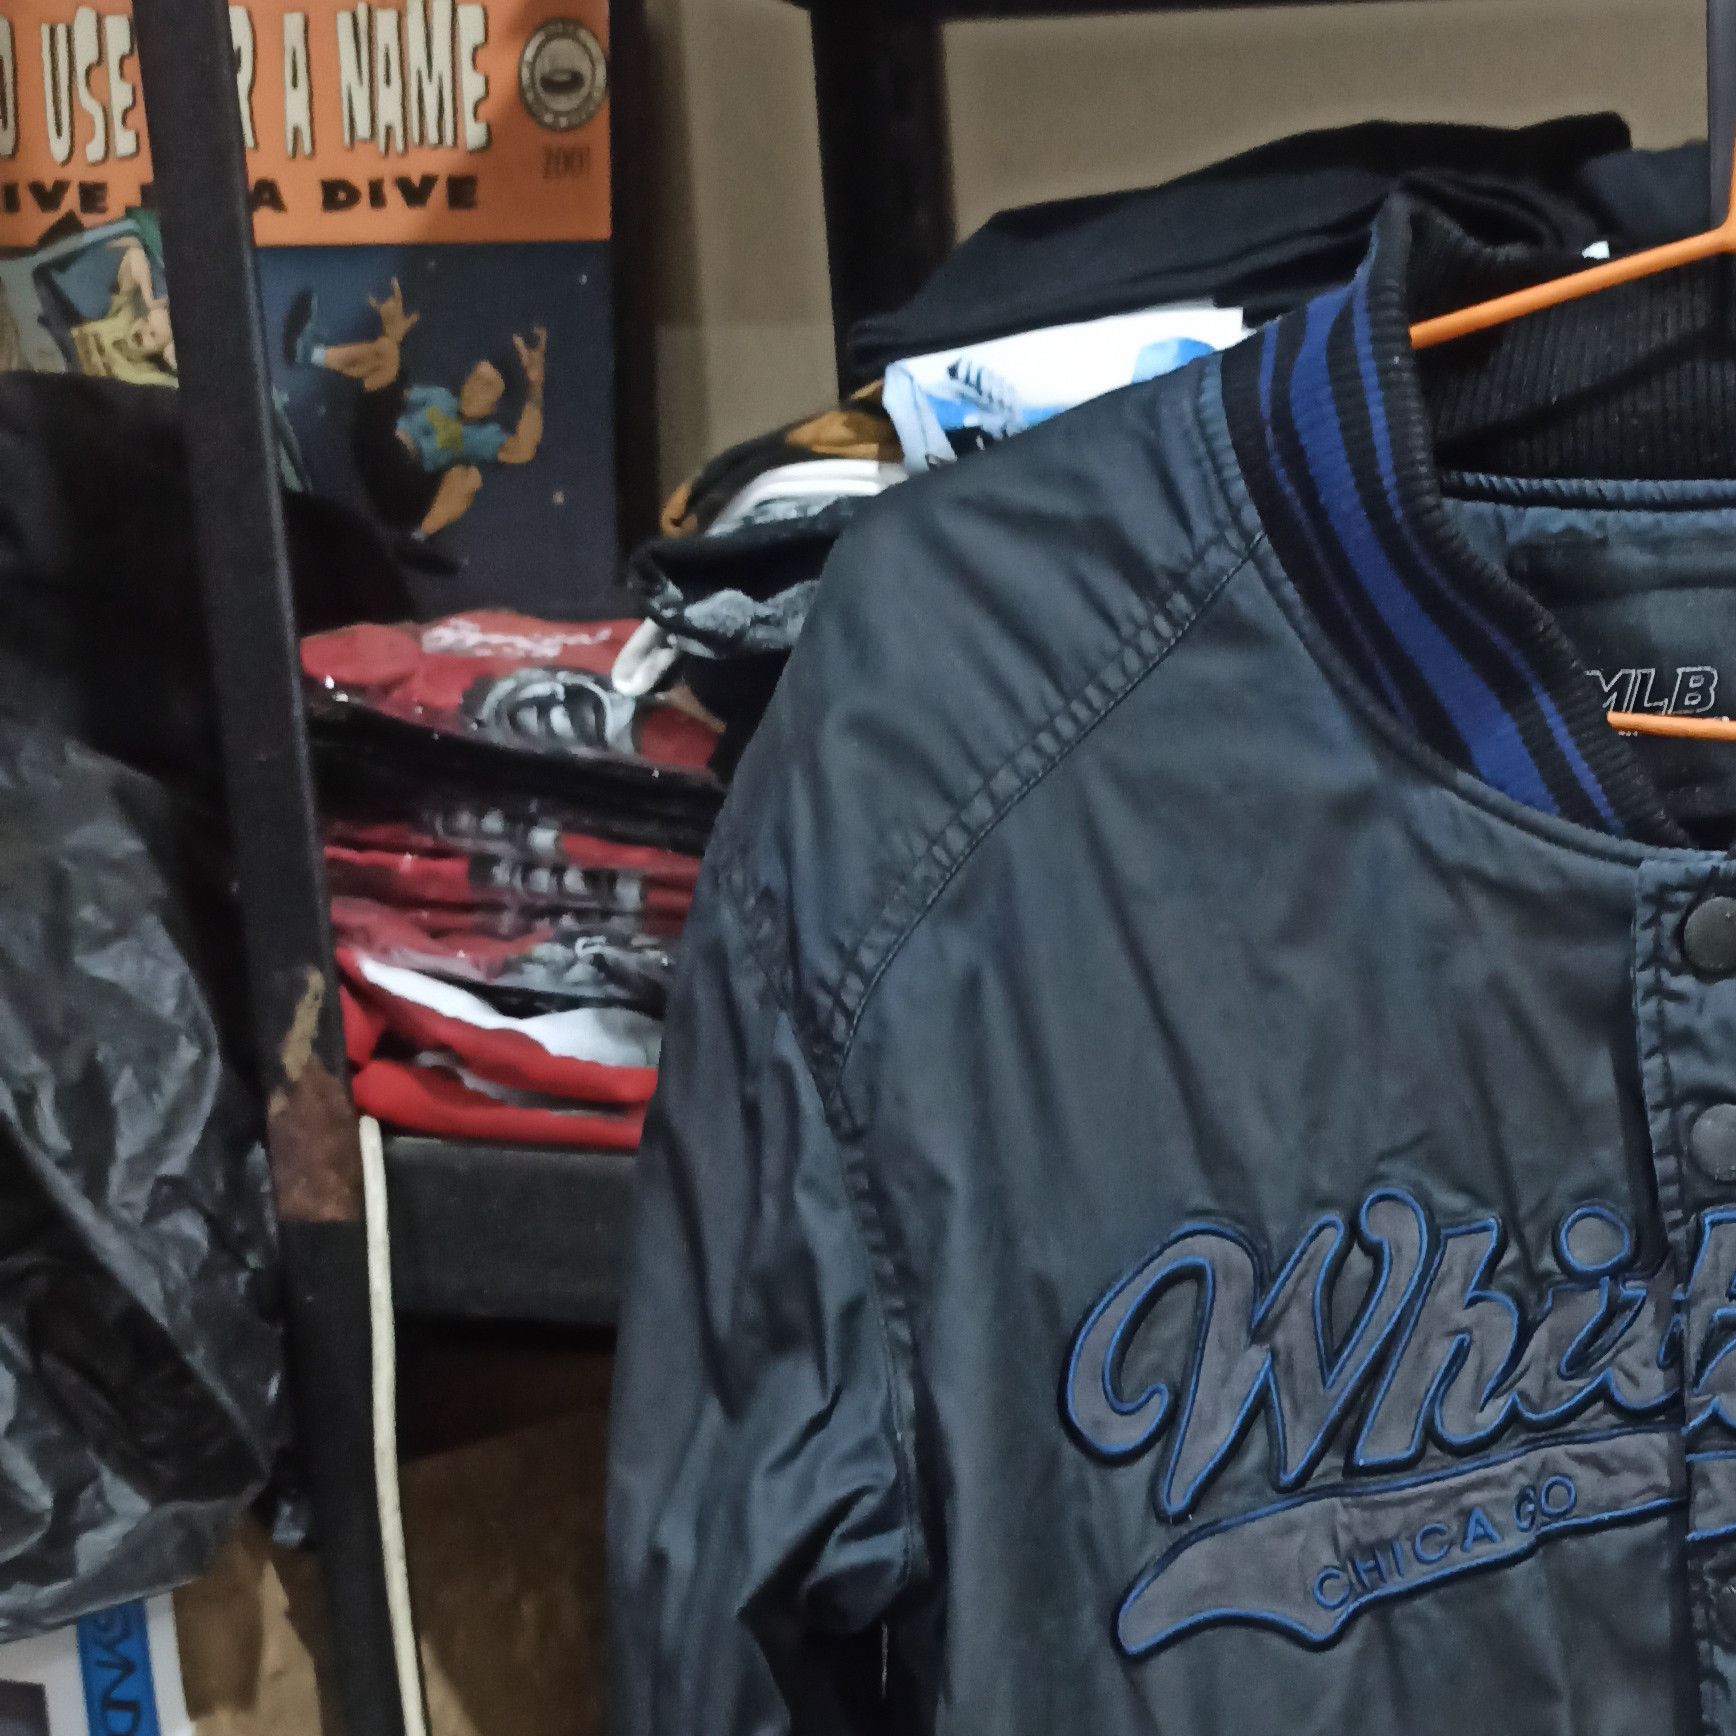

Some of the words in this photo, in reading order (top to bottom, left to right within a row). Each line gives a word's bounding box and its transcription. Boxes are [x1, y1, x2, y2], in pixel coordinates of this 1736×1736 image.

[40, 6, 140, 165] USE
[283, 11, 315, 159] A
[336, 0, 490, 156] NAME
[2, 180, 108, 214] IVE
[251, 178, 287, 212] A
[321, 175, 478, 212] DIVE
[1584, 665, 1719, 715] MLB
[1312, 1473, 1578, 1611] CHICAGO
